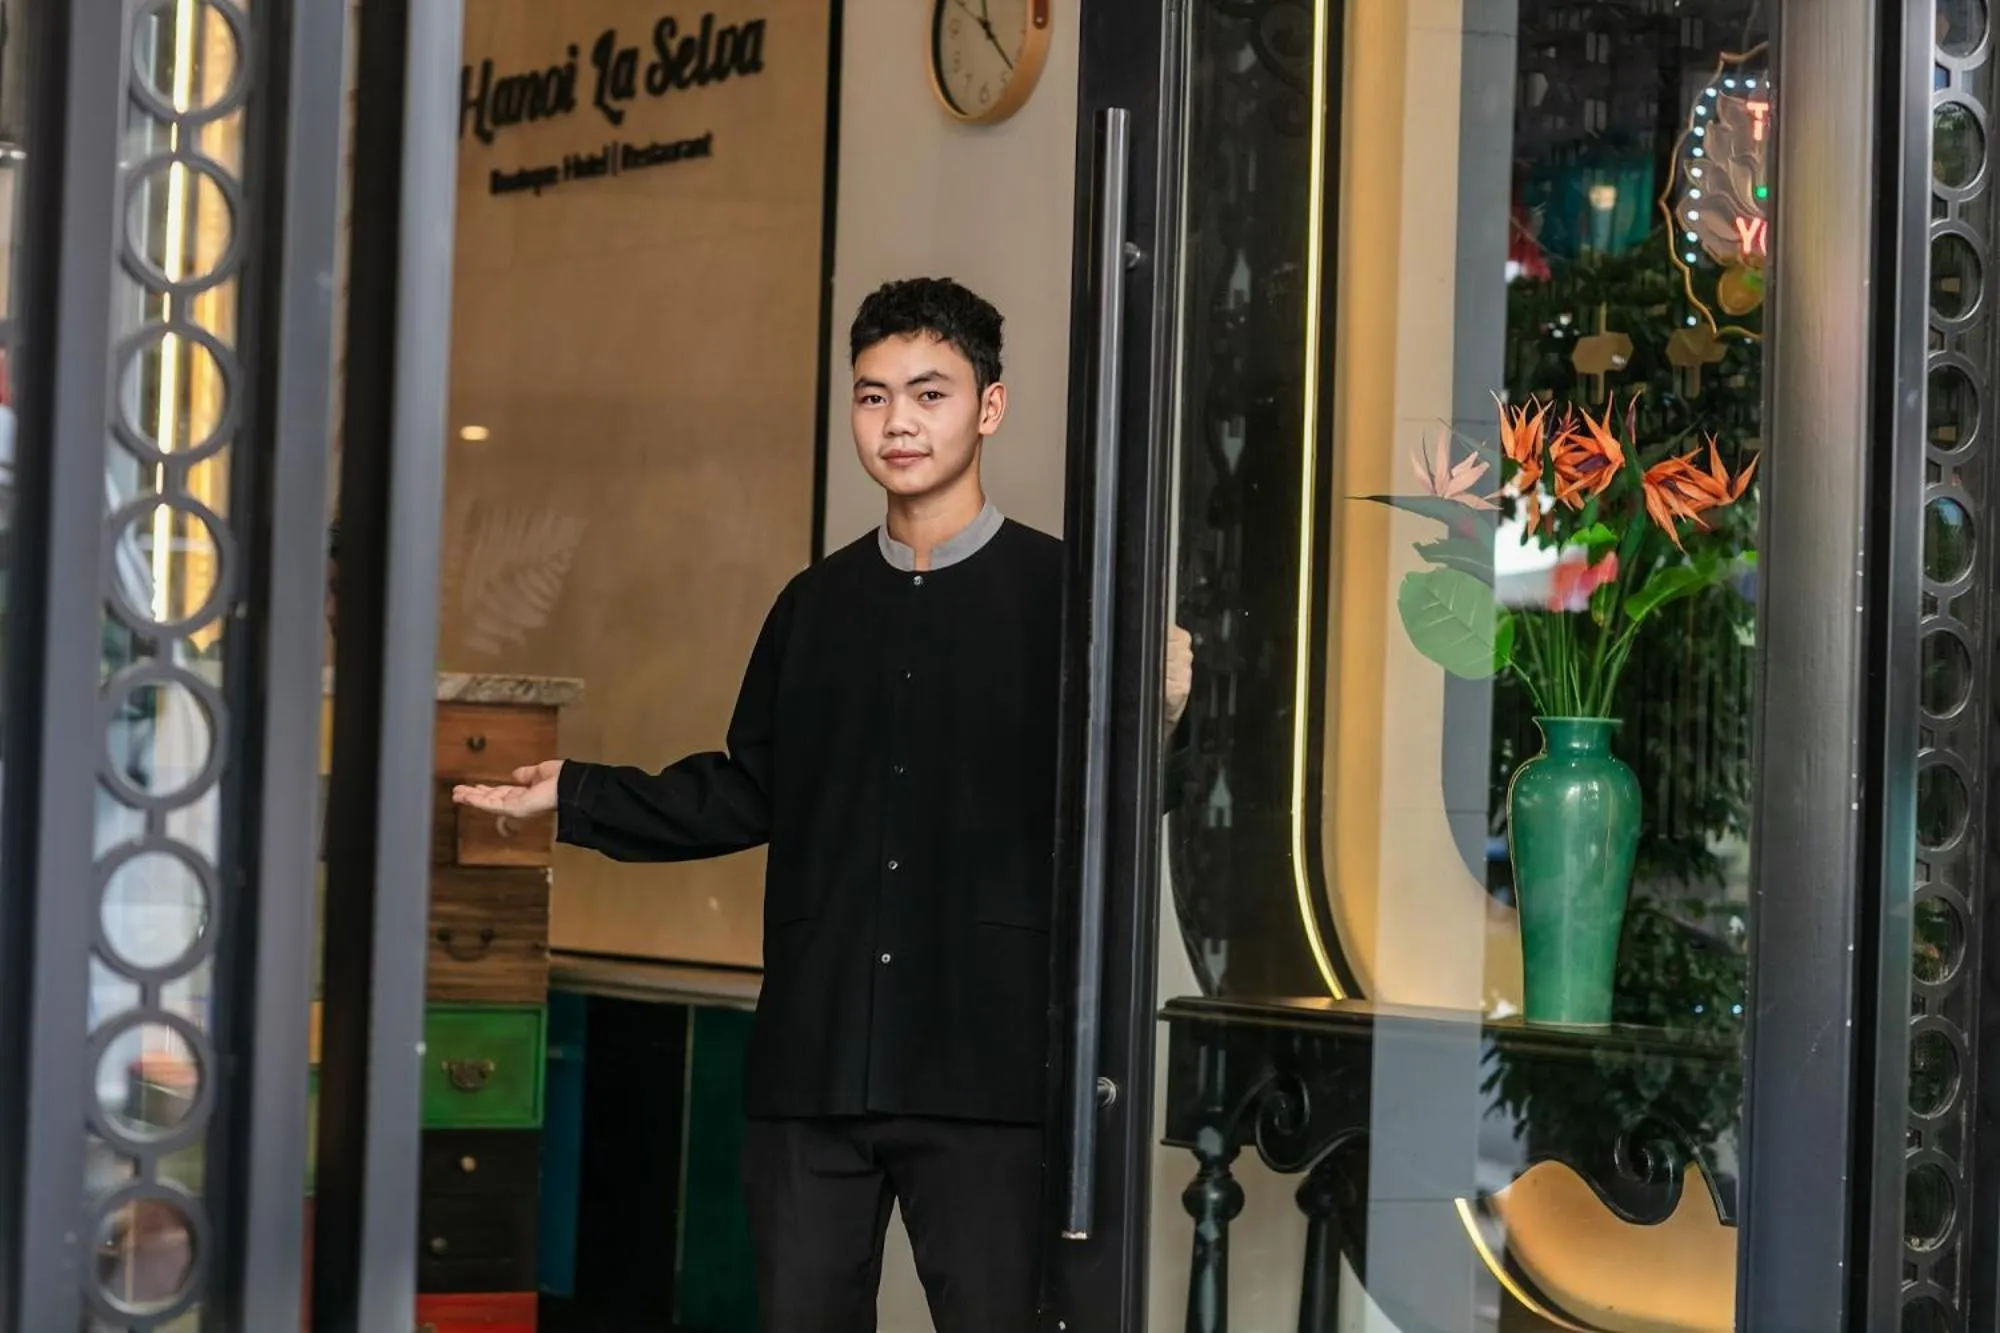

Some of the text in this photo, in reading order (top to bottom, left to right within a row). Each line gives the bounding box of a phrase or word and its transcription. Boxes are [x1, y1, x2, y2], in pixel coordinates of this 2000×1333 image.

[458, 12, 766, 145] Hanoi La Selva
